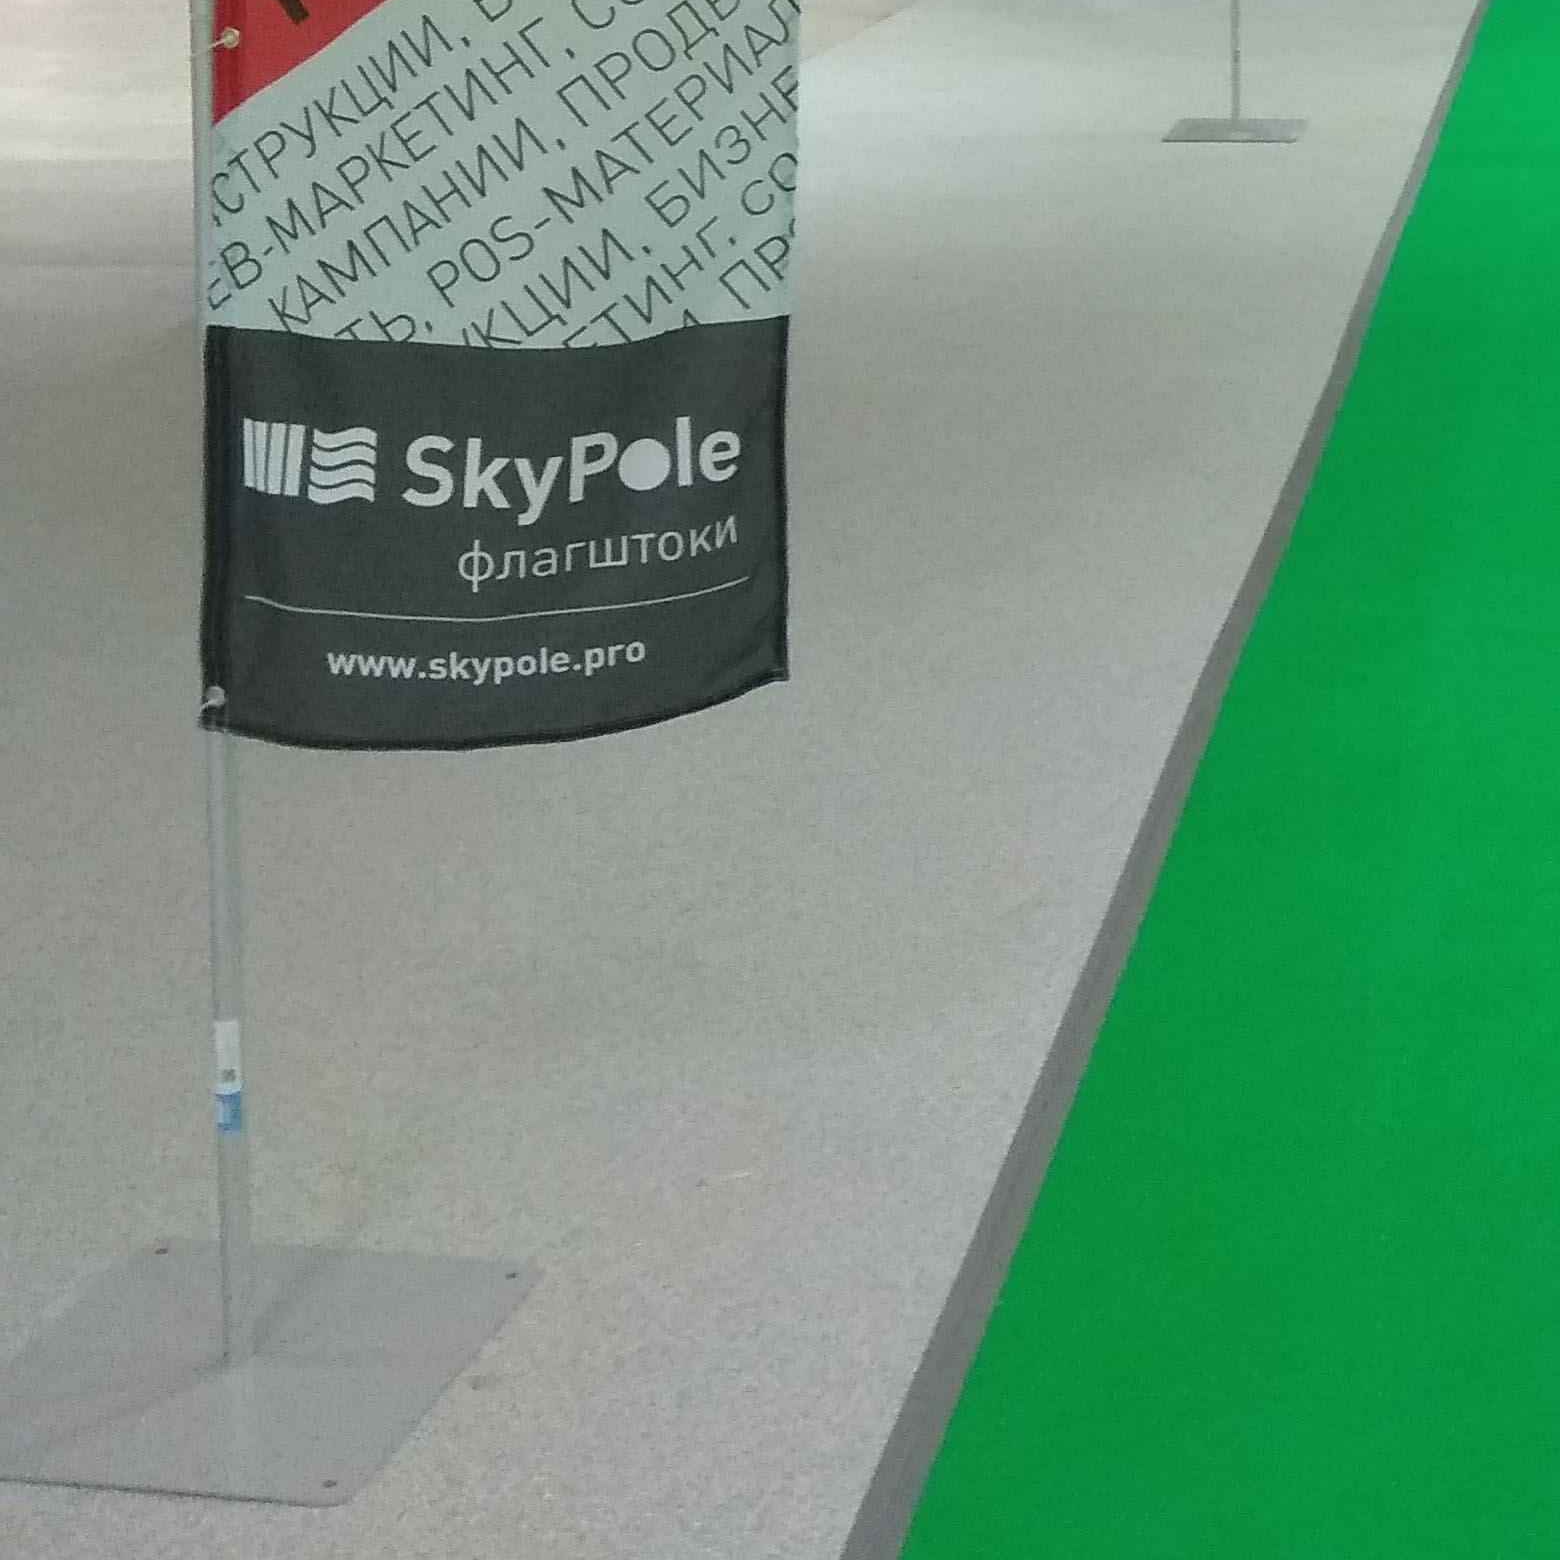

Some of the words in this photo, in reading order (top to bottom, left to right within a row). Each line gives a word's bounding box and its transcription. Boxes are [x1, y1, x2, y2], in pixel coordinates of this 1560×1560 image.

[402, 416, 742, 526] SkyPole
[458, 515, 738, 593] флагштоки
[326, 641, 647, 686] www.skypole.pro
